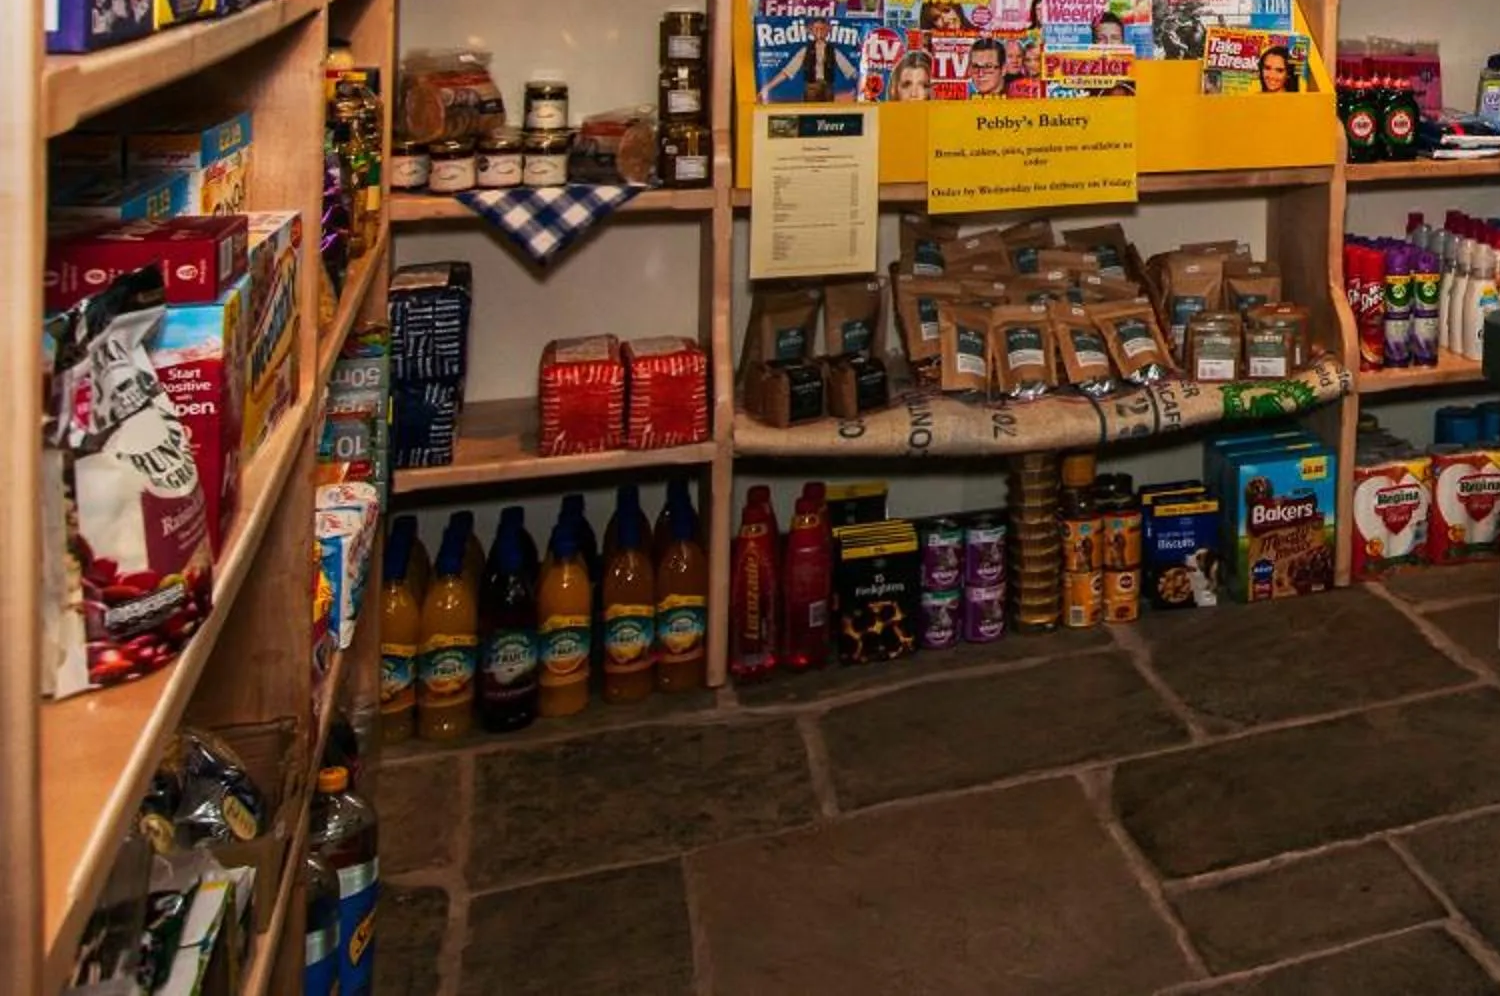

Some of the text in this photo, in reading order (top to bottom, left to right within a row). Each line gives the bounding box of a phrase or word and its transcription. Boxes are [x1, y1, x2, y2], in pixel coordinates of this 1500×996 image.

[765, 0, 836, 17] Friend
[757, 18, 815, 48] Radi
[865, 33, 901, 61] tv
[1208, 37, 1243, 55] Take
[935, 53, 971, 78] TV
[1045, 55, 1130, 77] Puzzler
[1221, 53, 1260, 72] Break
[976, 112, 1089, 133] Pebby's Bakery
[167, 367, 202, 380] Start
[171, 401, 216, 418] pen
[1251, 503, 1314, 525] Bakers
